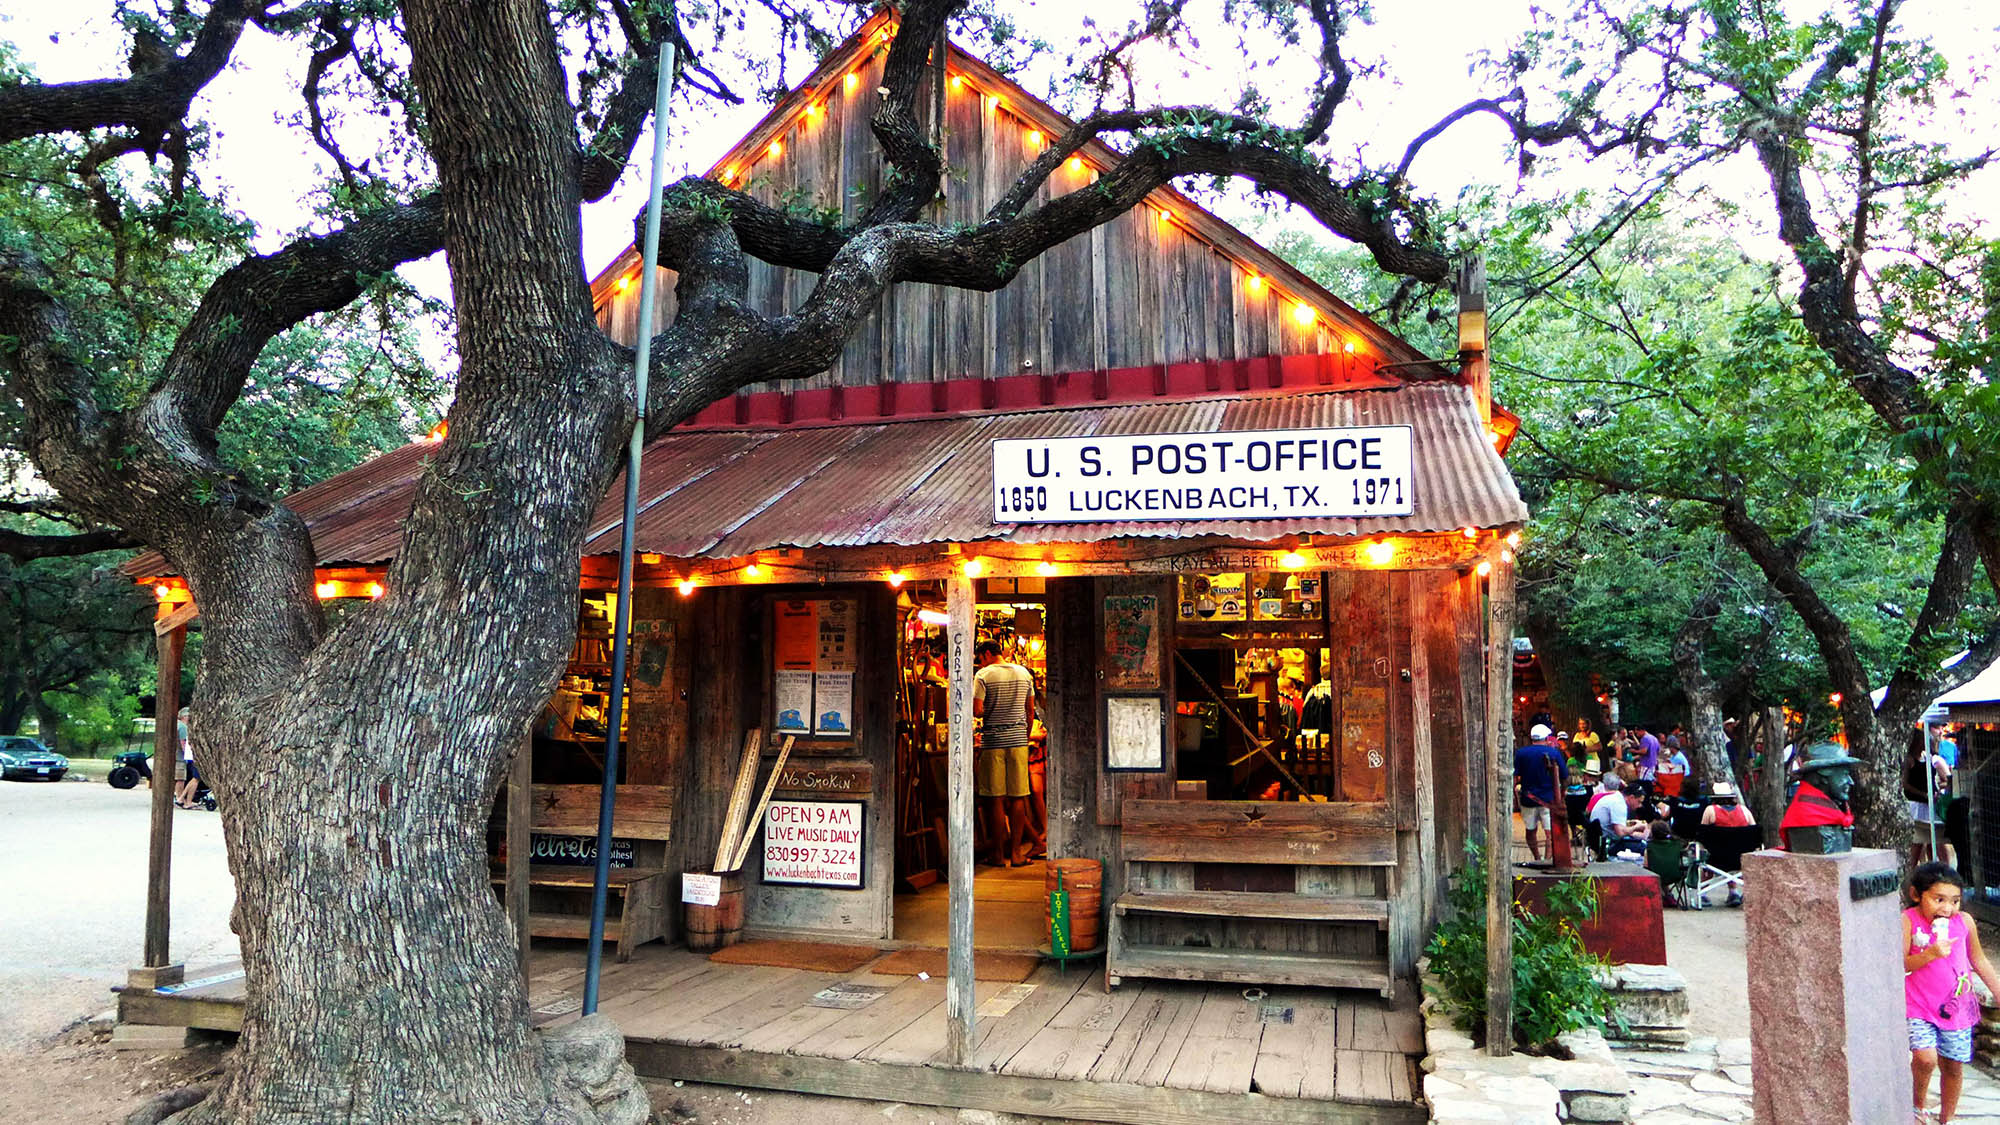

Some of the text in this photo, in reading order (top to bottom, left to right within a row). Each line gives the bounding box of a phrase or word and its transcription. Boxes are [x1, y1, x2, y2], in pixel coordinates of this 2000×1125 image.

[1027, 437, 1381, 478] U. S. POST-OFFICE
[1000, 486, 1046, 513] 1850
[1353, 477, 1403, 505] 1971
[780, 771, 799, 786] No
[770, 806, 811, 823] OPEN
[829, 809, 851, 825] AM
[767, 827, 860, 843] LIVE MUSIC DAILY
